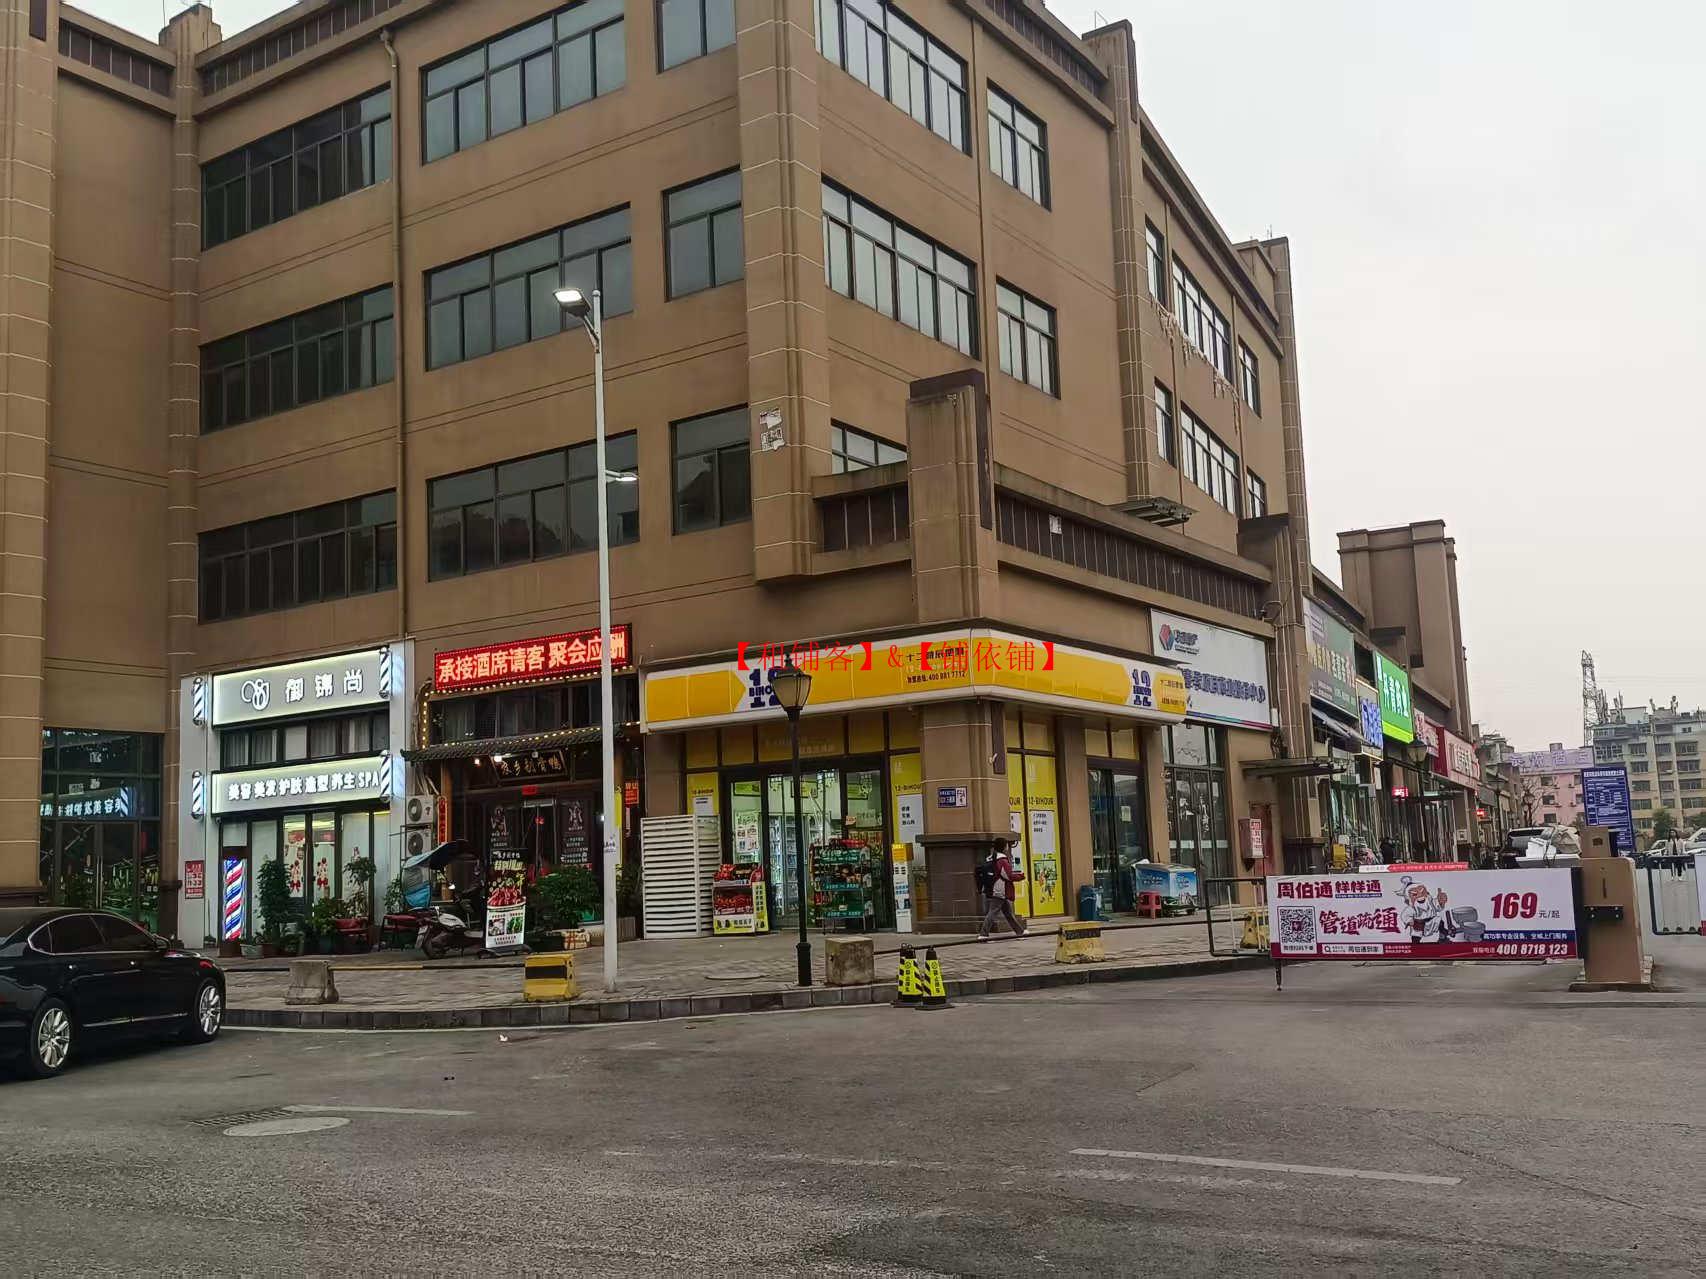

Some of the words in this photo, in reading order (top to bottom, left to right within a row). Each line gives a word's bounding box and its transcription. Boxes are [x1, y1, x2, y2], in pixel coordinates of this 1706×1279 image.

[438, 646, 545, 683] 承接酒席请客
[253, 778, 278, 799] 美发
[278, 777, 303, 797] 护肤
[357, 771, 379, 788] SPA
[1277, 881, 1333, 899] 周伯通
[1491, 892, 1538, 919] 169
[1319, 906, 1401, 935] 管道疏通
[1496, 944, 1518, 955] 400
[1520, 944, 1546, 955] 8718
[1549, 943, 1568, 954] 123
